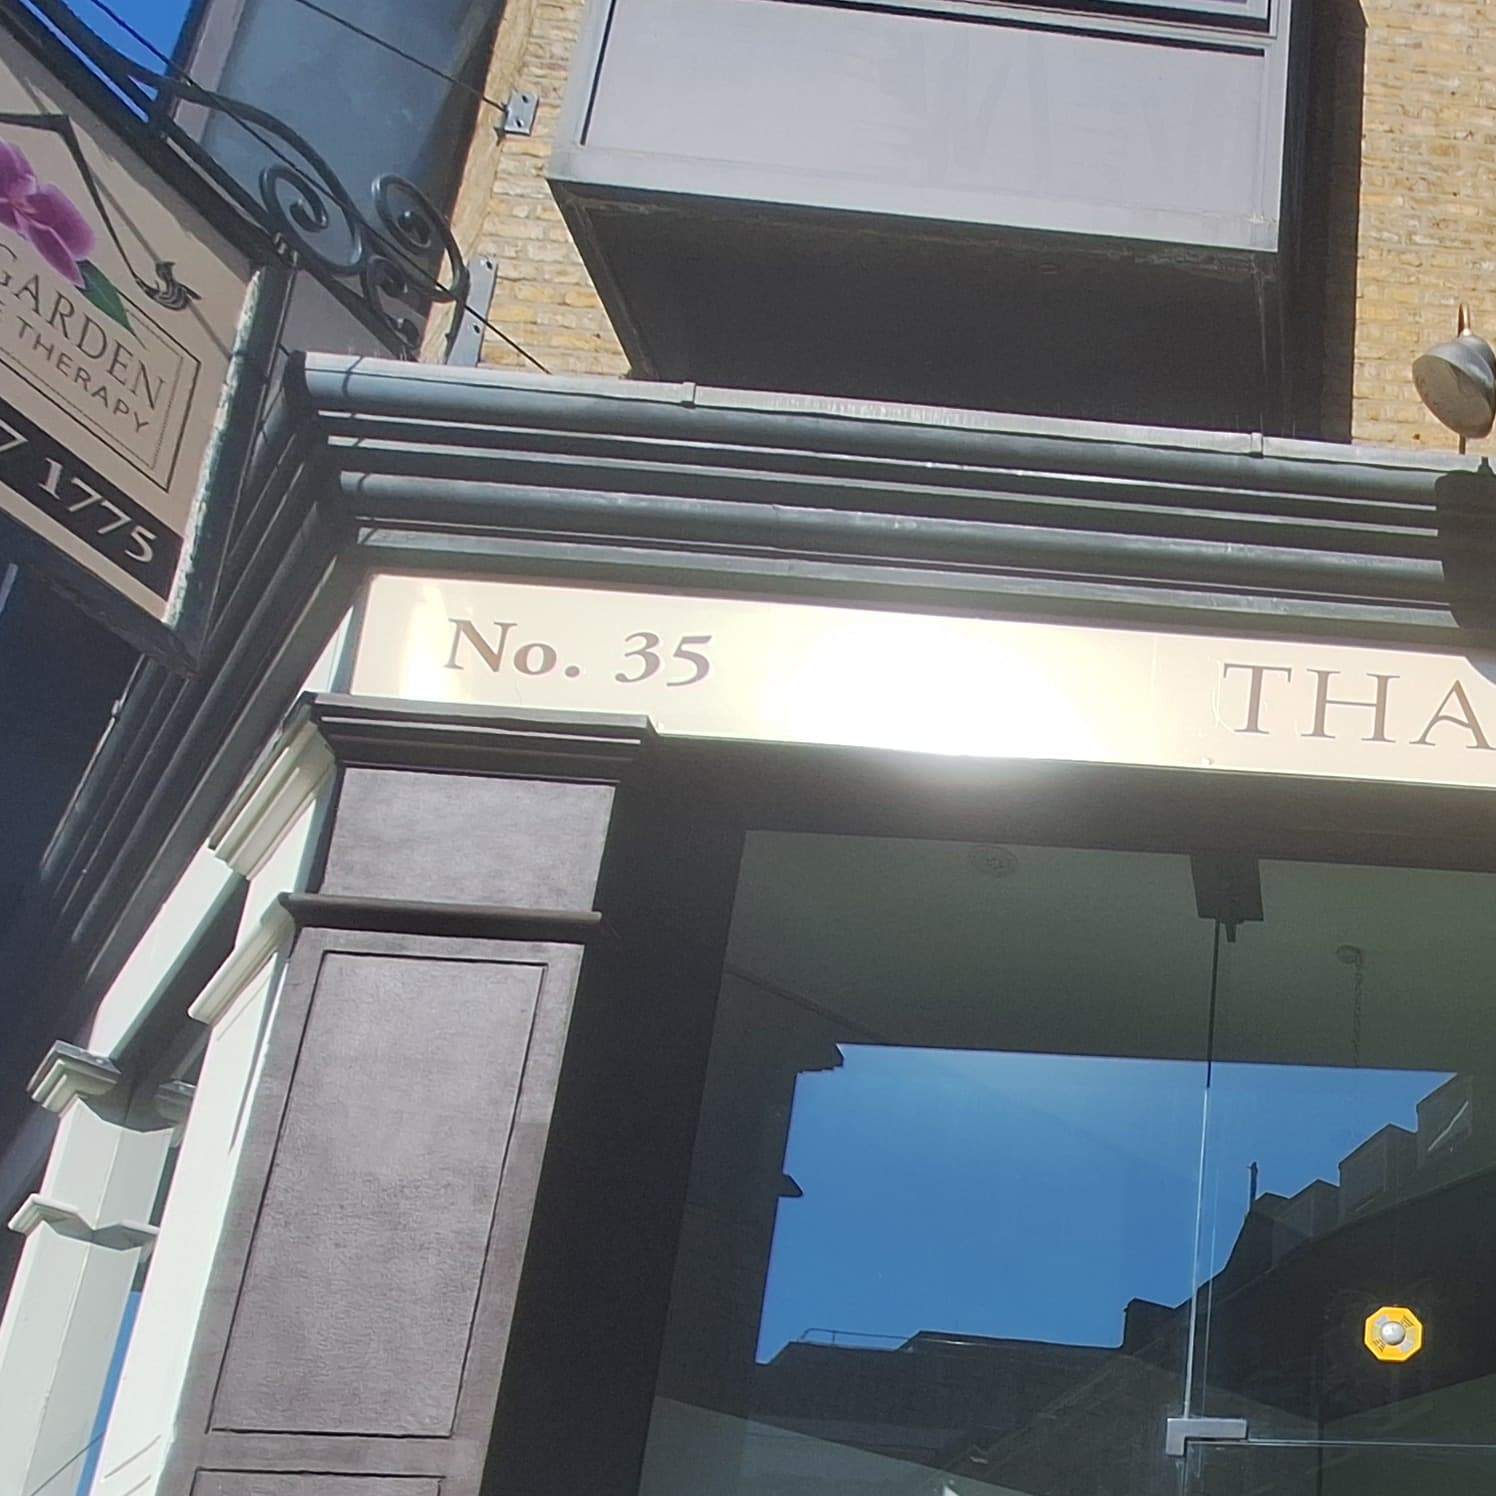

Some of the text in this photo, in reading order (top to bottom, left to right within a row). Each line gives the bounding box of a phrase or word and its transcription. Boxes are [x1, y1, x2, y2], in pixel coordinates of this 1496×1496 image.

[17, 315, 150, 433] THERAPY
[38, 457, 157, 563] 1775
[444, 617, 712, 686] No. 35
